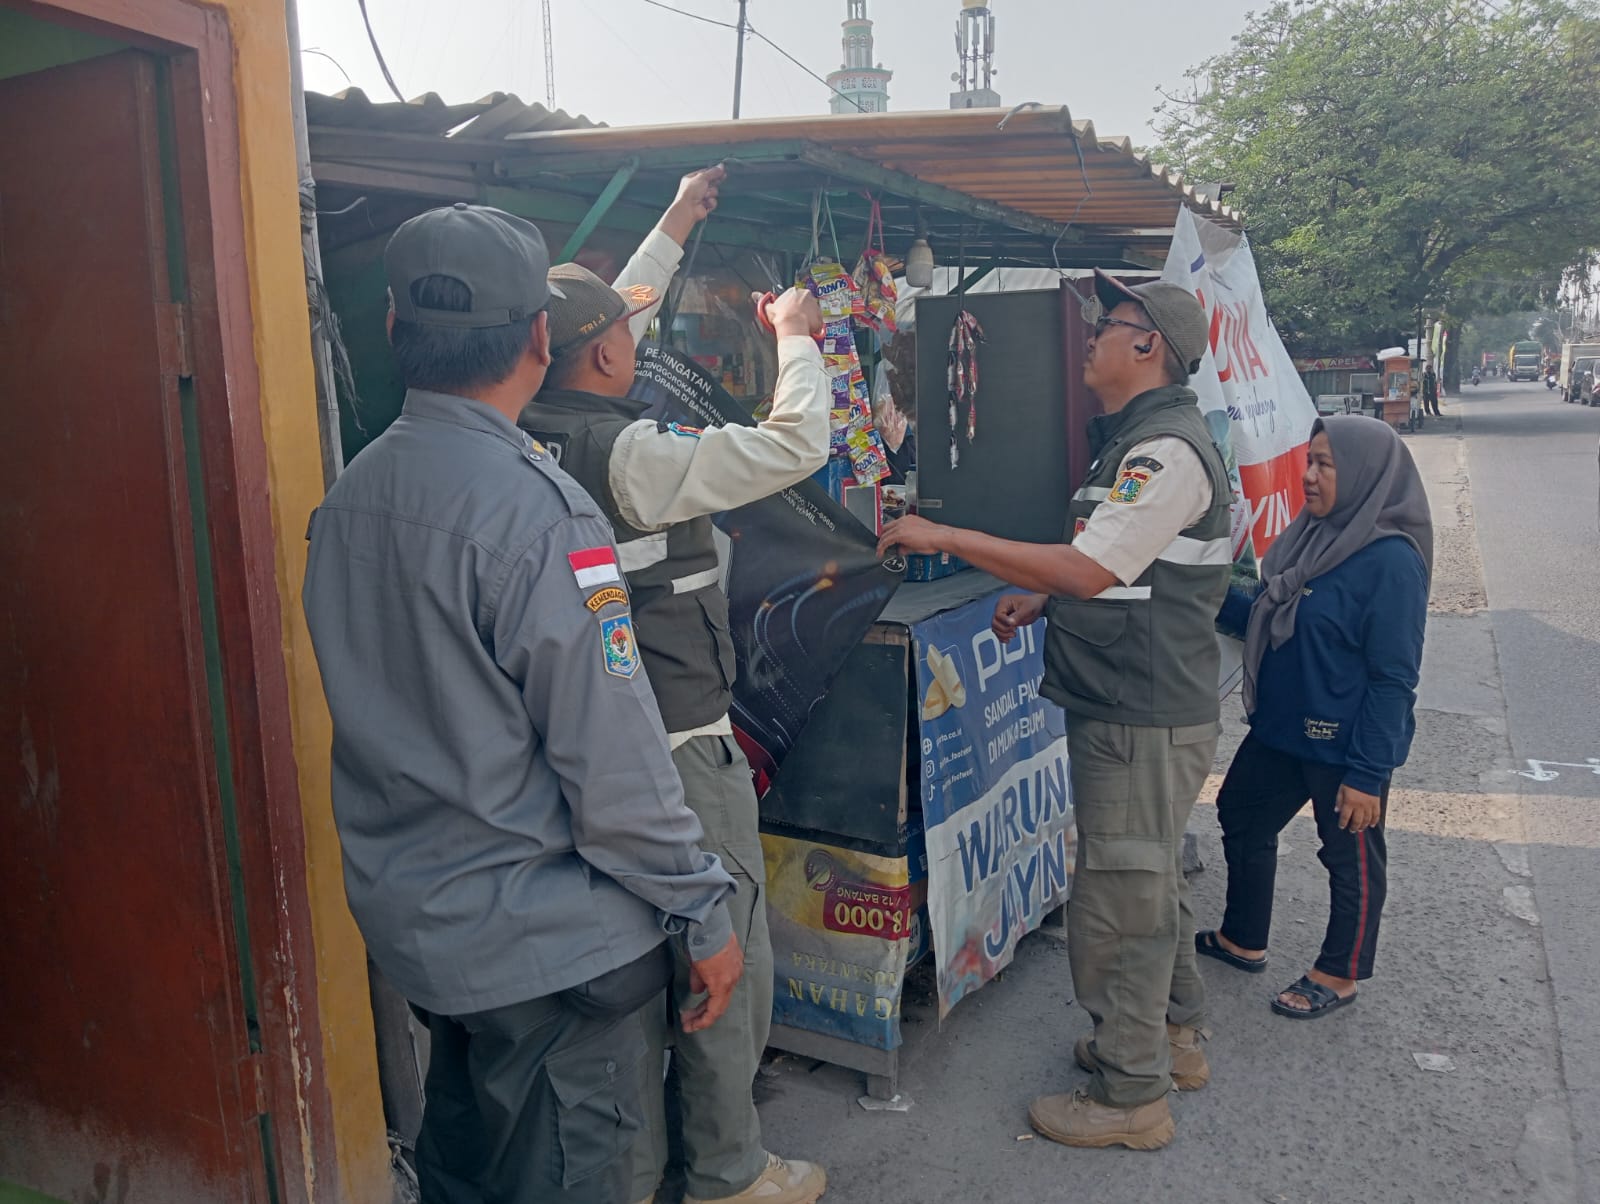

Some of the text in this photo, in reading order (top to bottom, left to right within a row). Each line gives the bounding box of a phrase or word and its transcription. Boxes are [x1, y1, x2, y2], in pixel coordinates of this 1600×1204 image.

[654, 374, 681, 397] ORANG
[680, 393, 689, 404] DI
[984, 688, 1018, 728] SANDAL
[1019, 708, 1045, 739] BUMI
[837, 887, 879, 904] BATANG
[881, 895, 894, 906] 12
[791, 952, 898, 987] NUSANTARA
